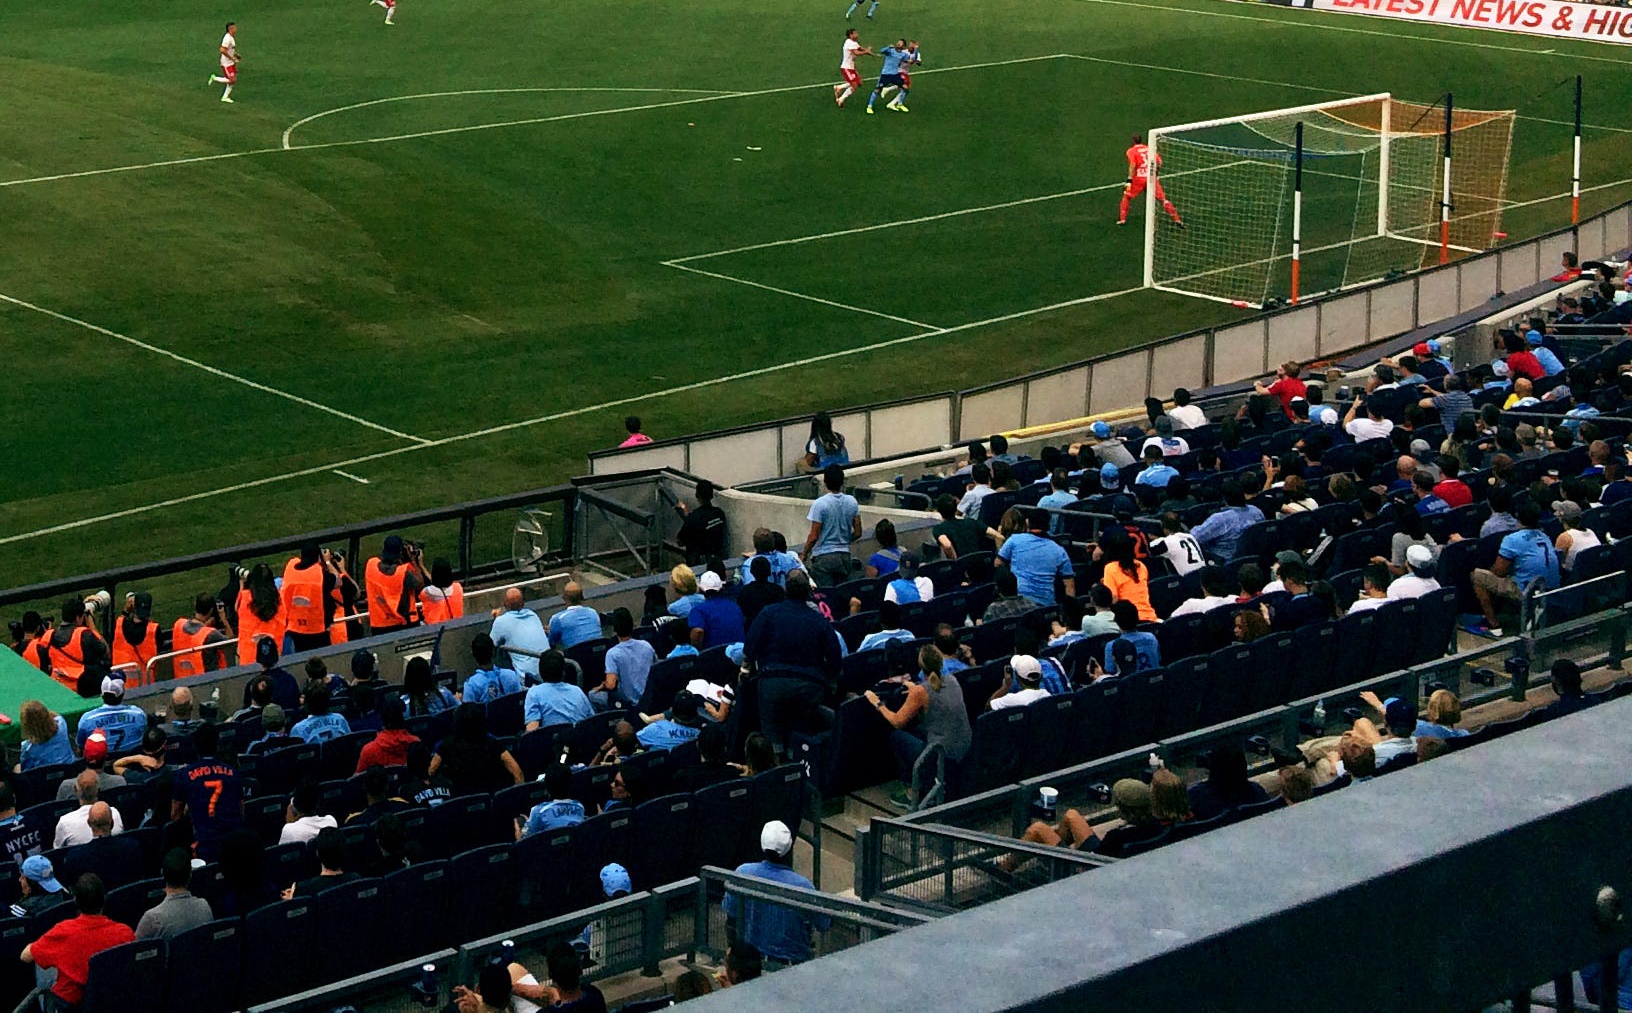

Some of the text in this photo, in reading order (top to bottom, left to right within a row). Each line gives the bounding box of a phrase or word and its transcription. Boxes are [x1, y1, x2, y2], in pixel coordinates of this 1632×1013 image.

[1551, 5, 1574, 31] &
[1179, 538, 1205, 565] 21
[188, 766, 234, 780] DAVID VILLA
[204, 779, 223, 817] 7
[414, 789, 433, 803] DAVID
[5, 830, 41, 854] NYCFC
